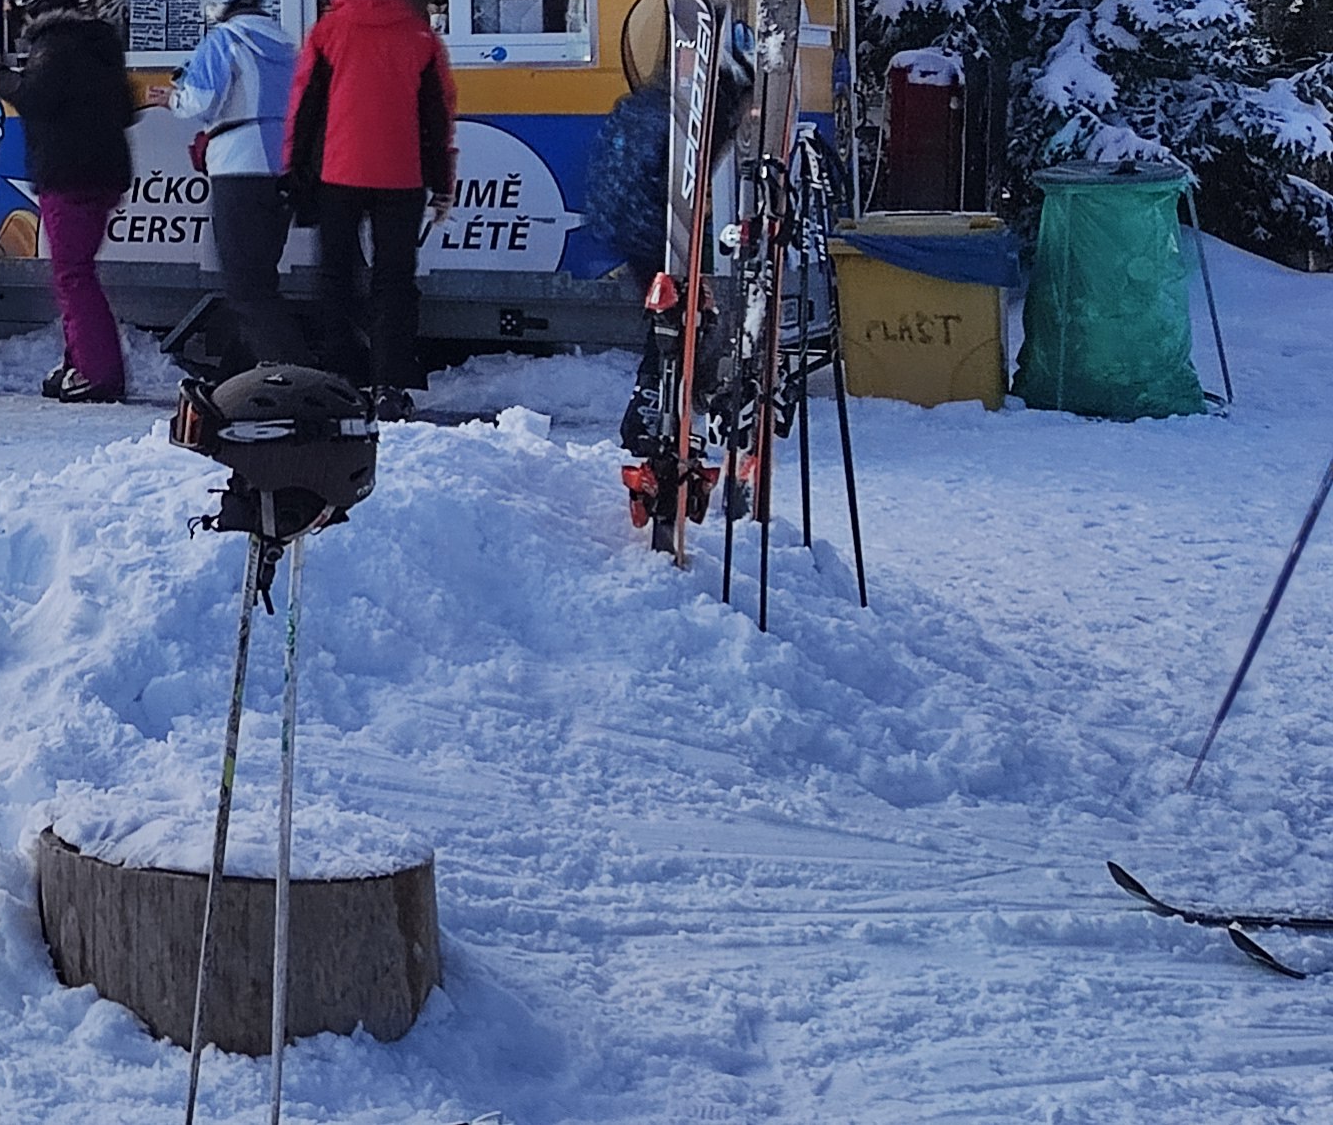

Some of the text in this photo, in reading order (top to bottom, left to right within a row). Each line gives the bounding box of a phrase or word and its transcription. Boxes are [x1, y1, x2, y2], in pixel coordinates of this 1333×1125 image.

[128, 170, 522, 208] IČKO IMĚ
[107, 209, 211, 243] ČERST
[441, 214, 531, 250] LÉTĚ
